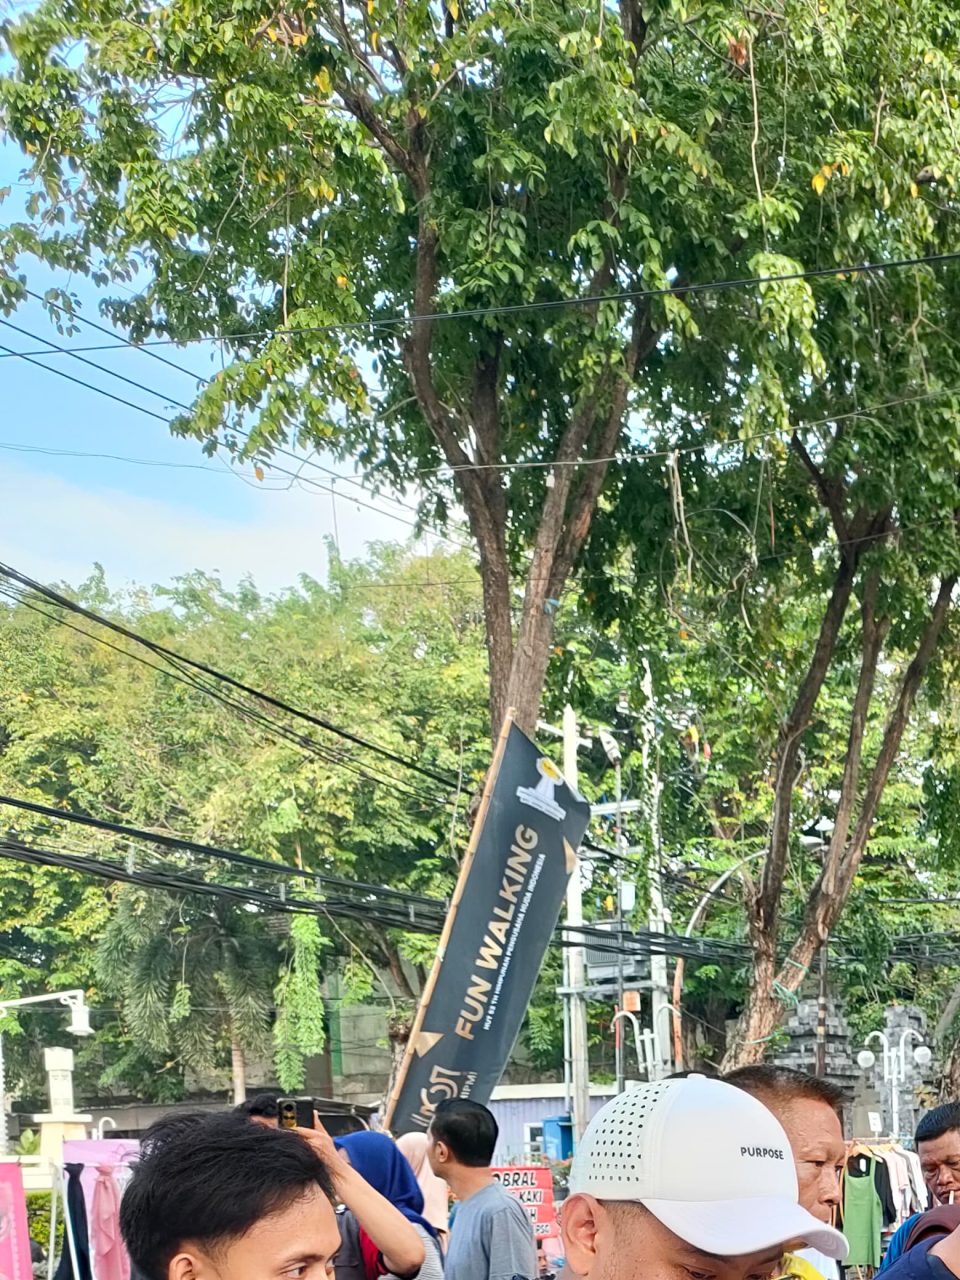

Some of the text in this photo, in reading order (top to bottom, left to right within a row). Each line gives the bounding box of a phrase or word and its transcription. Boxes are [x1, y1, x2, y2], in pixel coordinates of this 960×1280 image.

[527, 853, 547, 893] INDONESIA
[455, 824, 539, 1041] FUN WALKING
[740, 1146, 785, 1160] PURPOSE
[519, 1189, 543, 1204] KAKI
